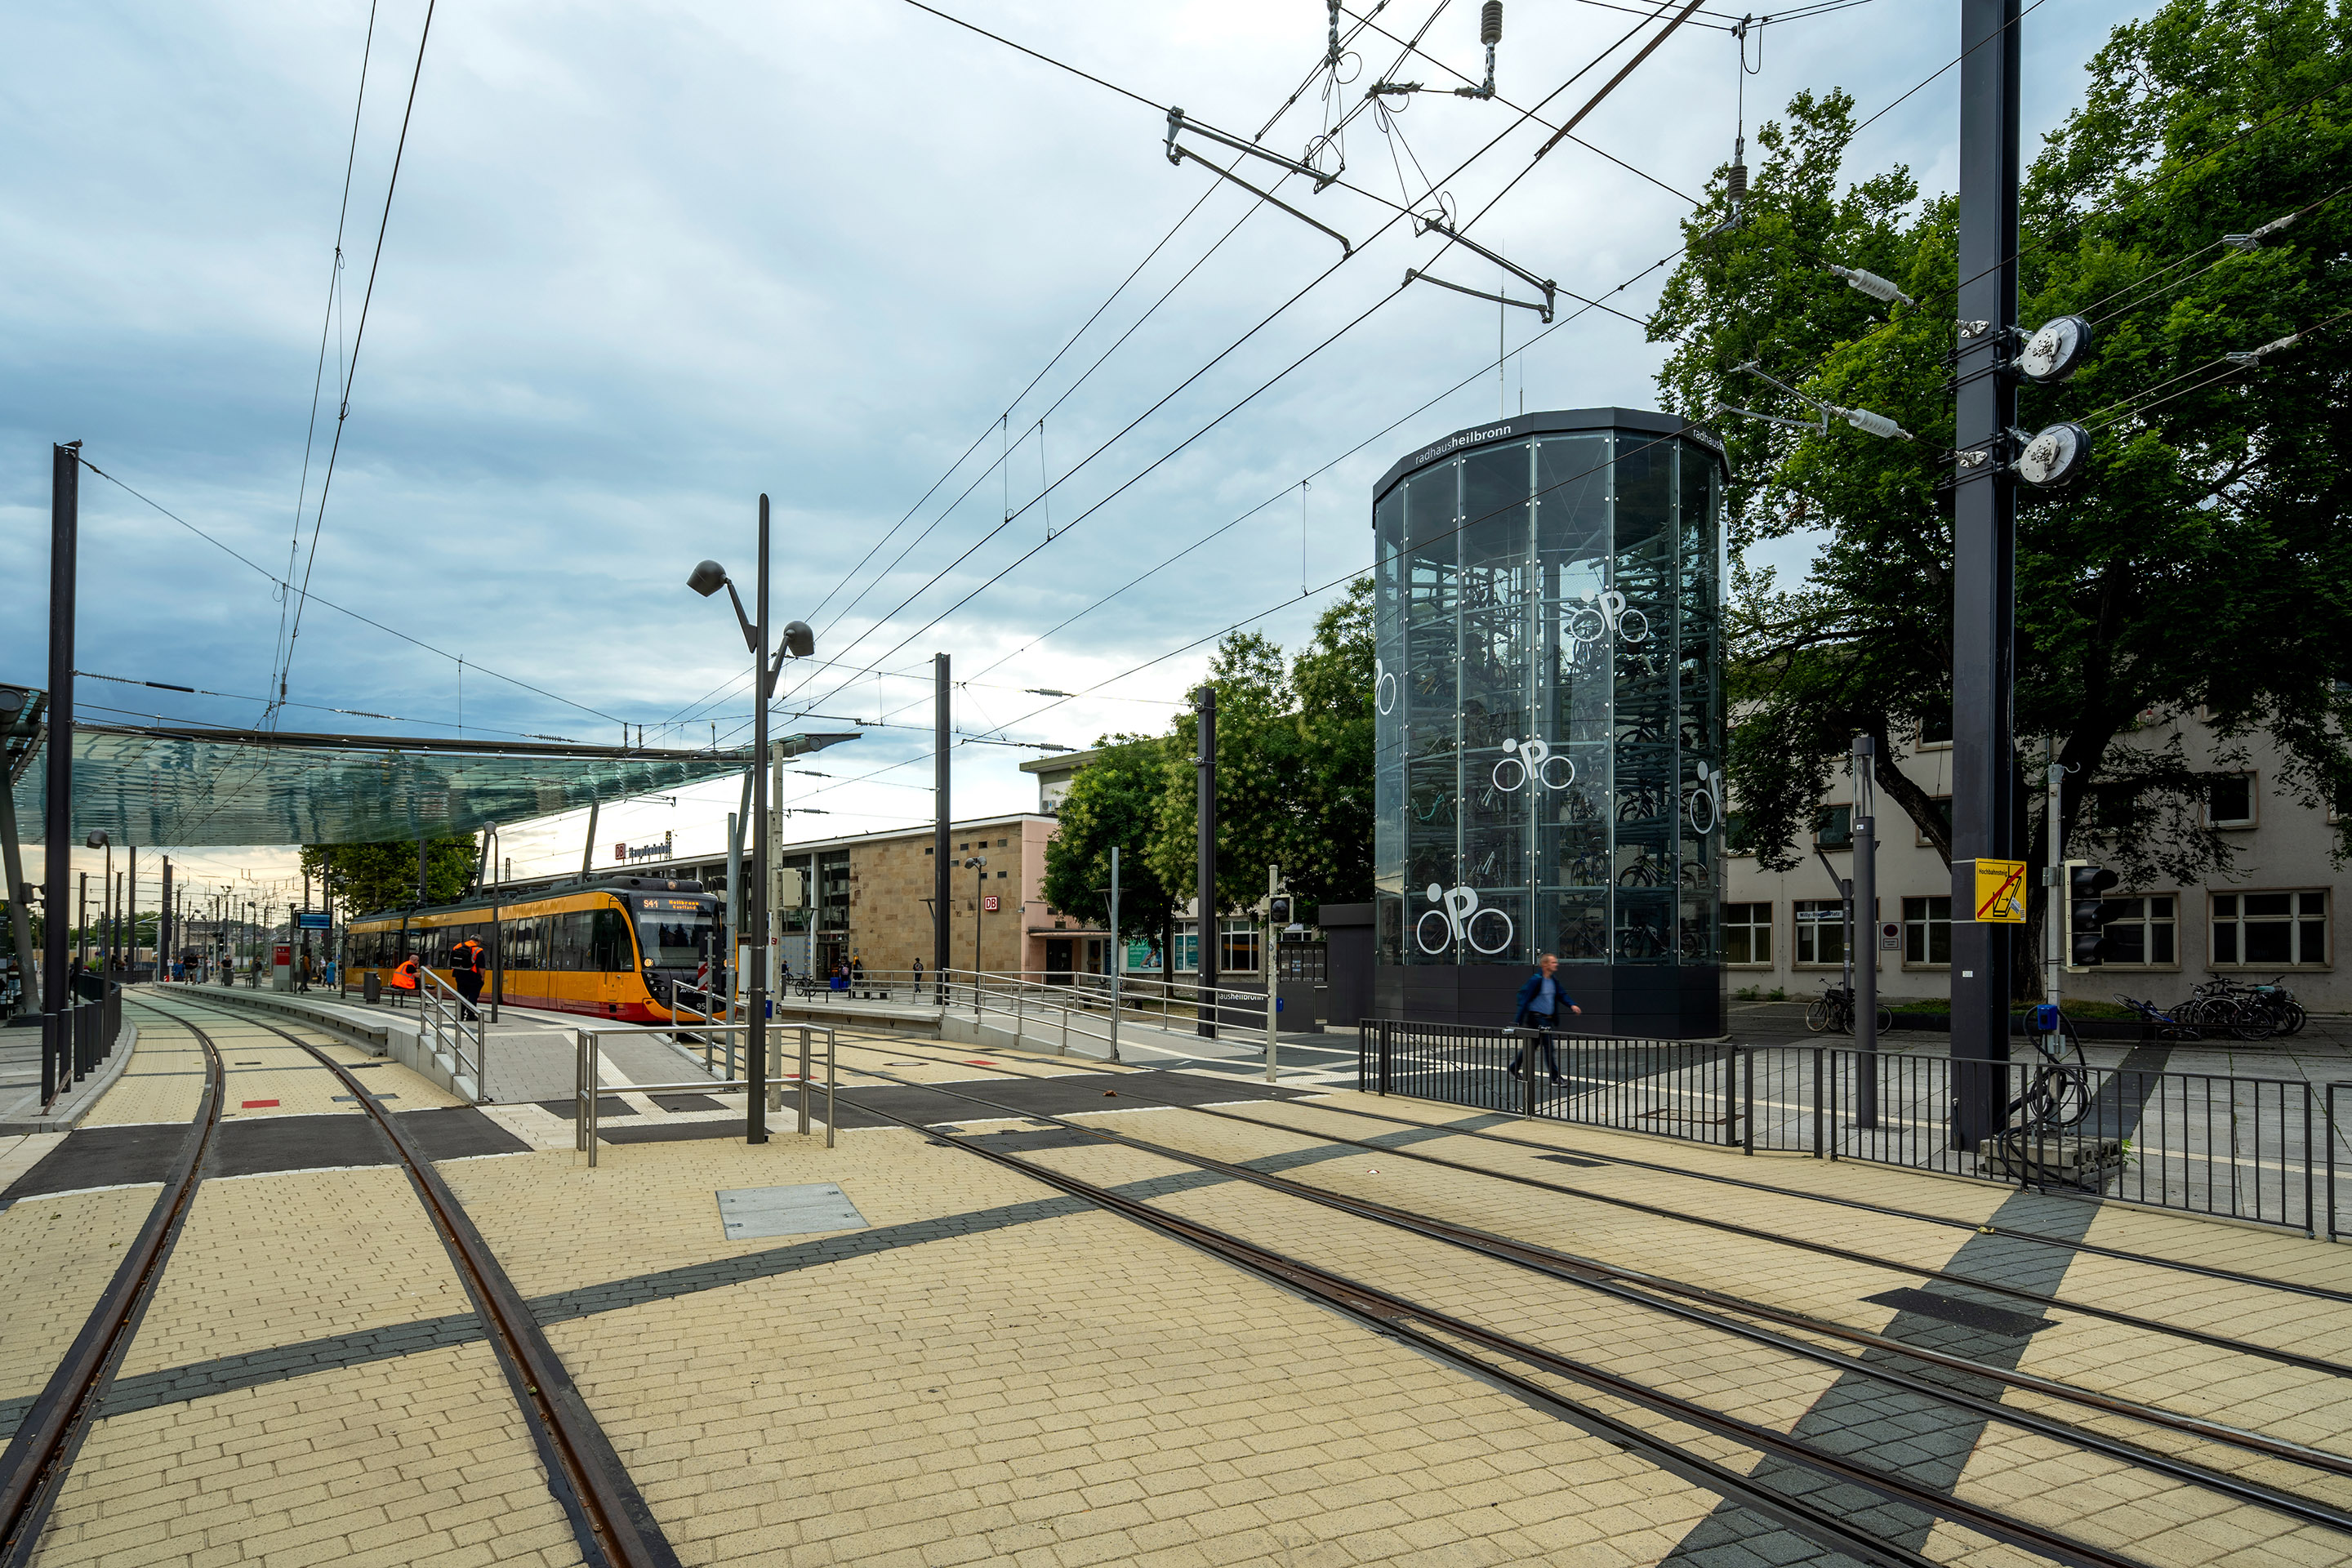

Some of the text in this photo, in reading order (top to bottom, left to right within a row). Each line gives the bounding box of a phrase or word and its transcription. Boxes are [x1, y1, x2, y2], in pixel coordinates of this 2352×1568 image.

[1415, 425, 1512, 465] radhausheilbronn
[1978, 868, 2008, 878] Hochbahnsteig
[643, 899, 658, 908] S41
